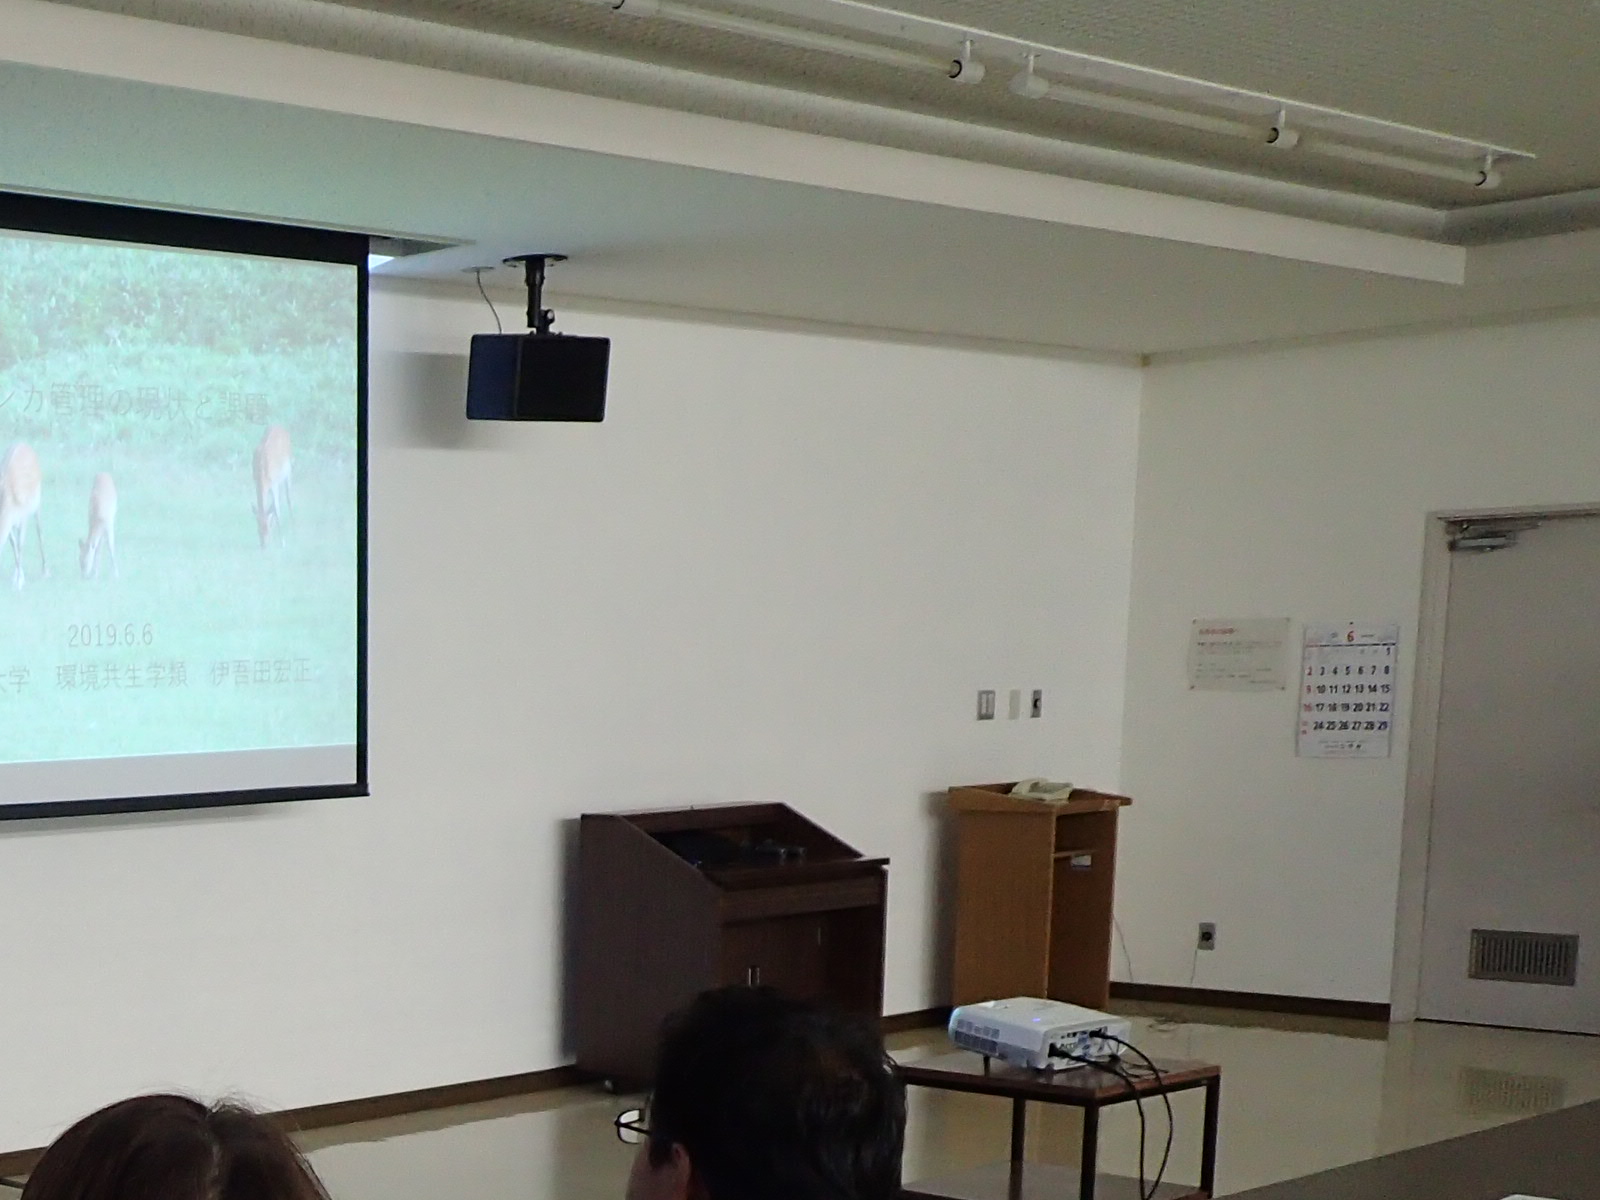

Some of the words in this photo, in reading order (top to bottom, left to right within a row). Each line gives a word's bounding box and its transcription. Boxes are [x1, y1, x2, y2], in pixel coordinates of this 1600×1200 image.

[67, 623, 154, 649] 2019.6.6
[1347, 630, 1354, 642] 6
[210, 656, 313, 687] 伊吾田宏正
[1307, 666, 1313, 676] 2
[1319, 666, 1325, 676] 3
[1332, 666, 1338, 676] 4
[1345, 666, 1351, 675] 5
[1357, 666, 1364, 675] 6
[1370, 666, 1376, 675] 7
[1384, 665, 1390, 675] 8
[1316, 684, 1326, 694] 10
[1329, 684, 1338, 694] 11
[1342, 684, 1351, 694] 12
[1355, 684, 1364, 693] 13
[1368, 684, 1377, 693] 14
[1380, 684, 1390, 693] 15
[1315, 702, 1325, 712] 17
[1352, 702, 1364, 712] 20
[1378, 702, 1390, 712] 22
